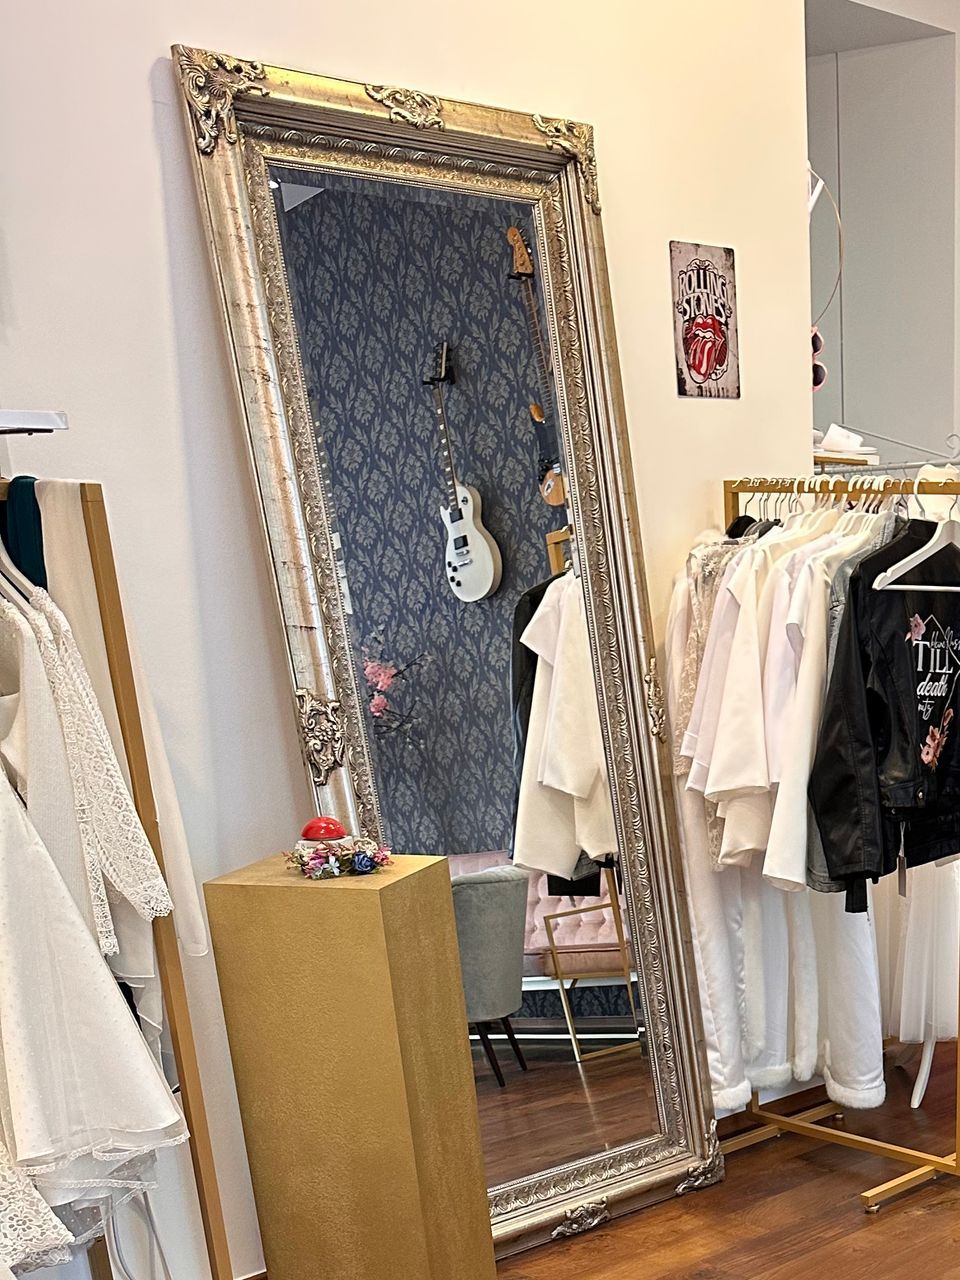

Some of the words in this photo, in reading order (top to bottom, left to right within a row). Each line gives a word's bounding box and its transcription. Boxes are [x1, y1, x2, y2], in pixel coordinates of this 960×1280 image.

[679, 269, 727, 303] ROLLING
[682, 292, 727, 323] STONES
[913, 641, 953, 674] TILL
[916, 673, 949, 697] death
